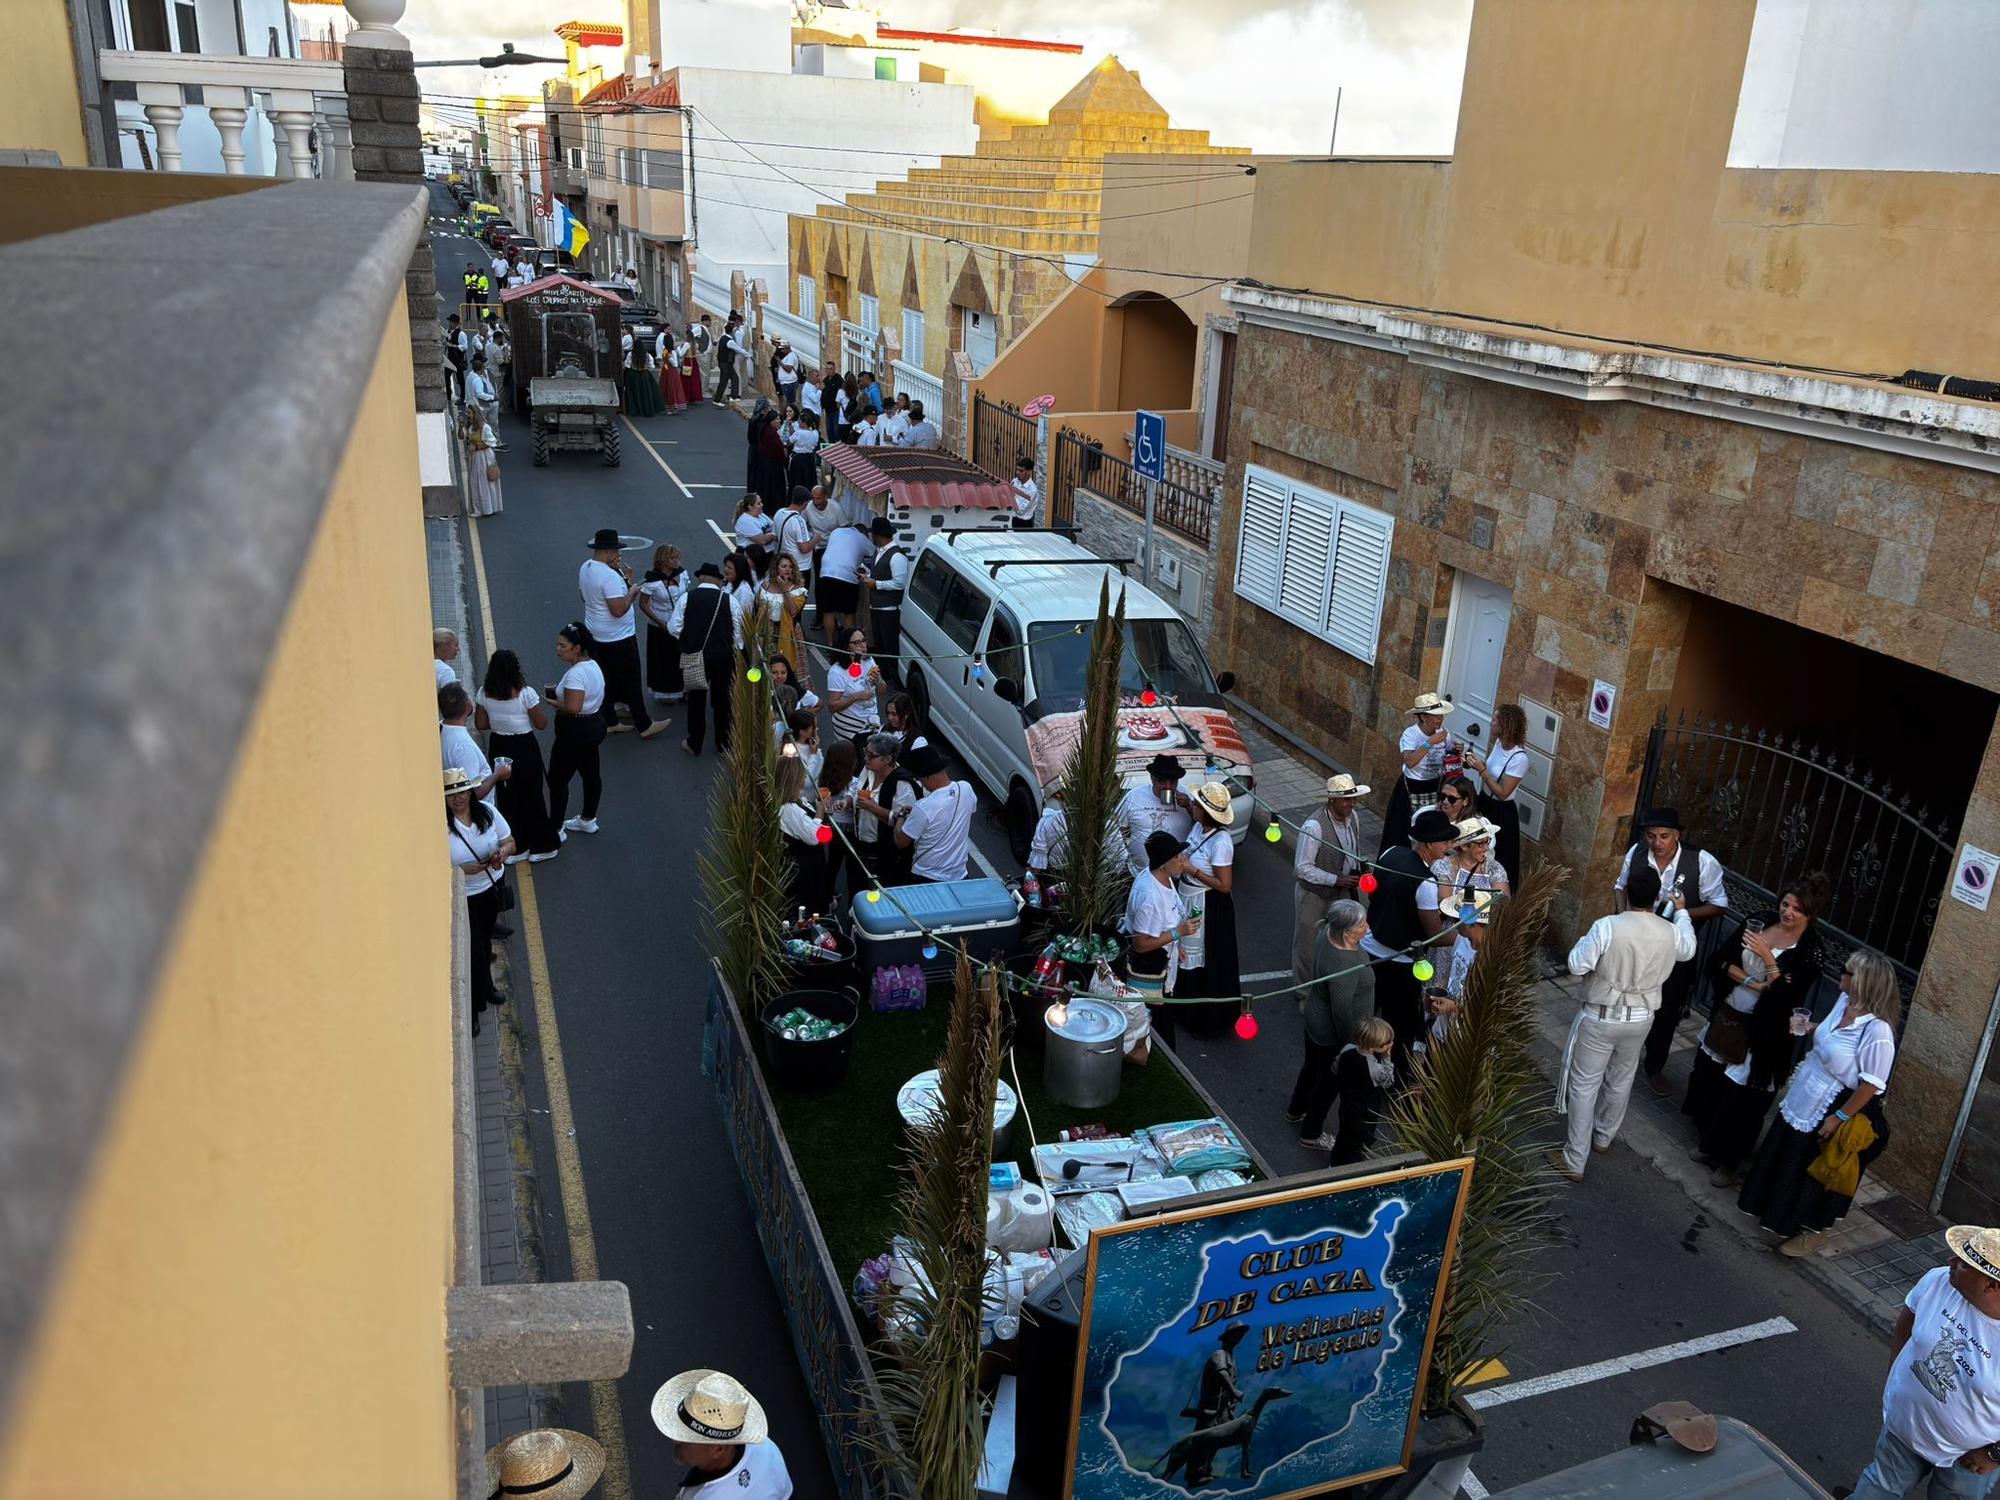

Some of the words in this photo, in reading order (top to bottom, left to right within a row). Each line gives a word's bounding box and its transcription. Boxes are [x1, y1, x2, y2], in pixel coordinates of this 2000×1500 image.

[1239, 1235, 1344, 1280] CLUB
[1966, 1247, 1983, 1264] RON
[1188, 1289, 1257, 1334] DE
[1268, 1267, 1375, 1305] CAZA
[1260, 1304, 1386, 1350] Medianias
[1956, 1323, 1969, 1338] DEL
[1968, 1337, 1991, 1359] MACHO
[1256, 1348, 1285, 1373] de
[1291, 1326, 1383, 1366] Ingenio
[1955, 1355, 1976, 1378] 2025
[690, 1420, 706, 1434] RON
